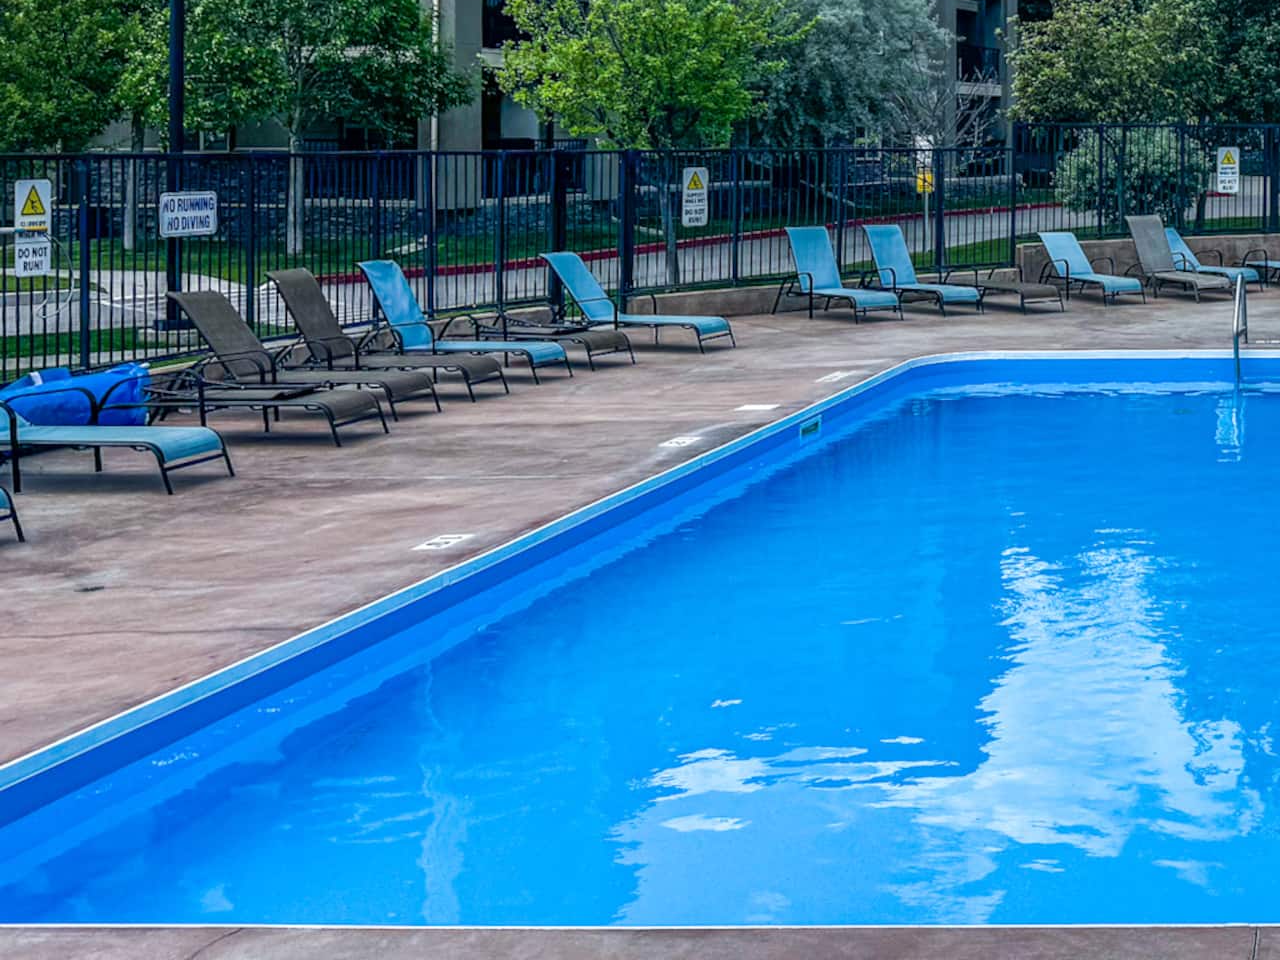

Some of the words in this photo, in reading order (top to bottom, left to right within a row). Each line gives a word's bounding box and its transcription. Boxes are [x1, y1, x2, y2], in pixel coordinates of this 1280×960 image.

[162, 199, 176, 213] NO
[177, 196, 215, 212] RUNNING
[167, 216, 180, 231] NO
[181, 215, 210, 230] DIVING
[18, 248, 31, 259] DO
[32, 246, 48, 258] NOT
